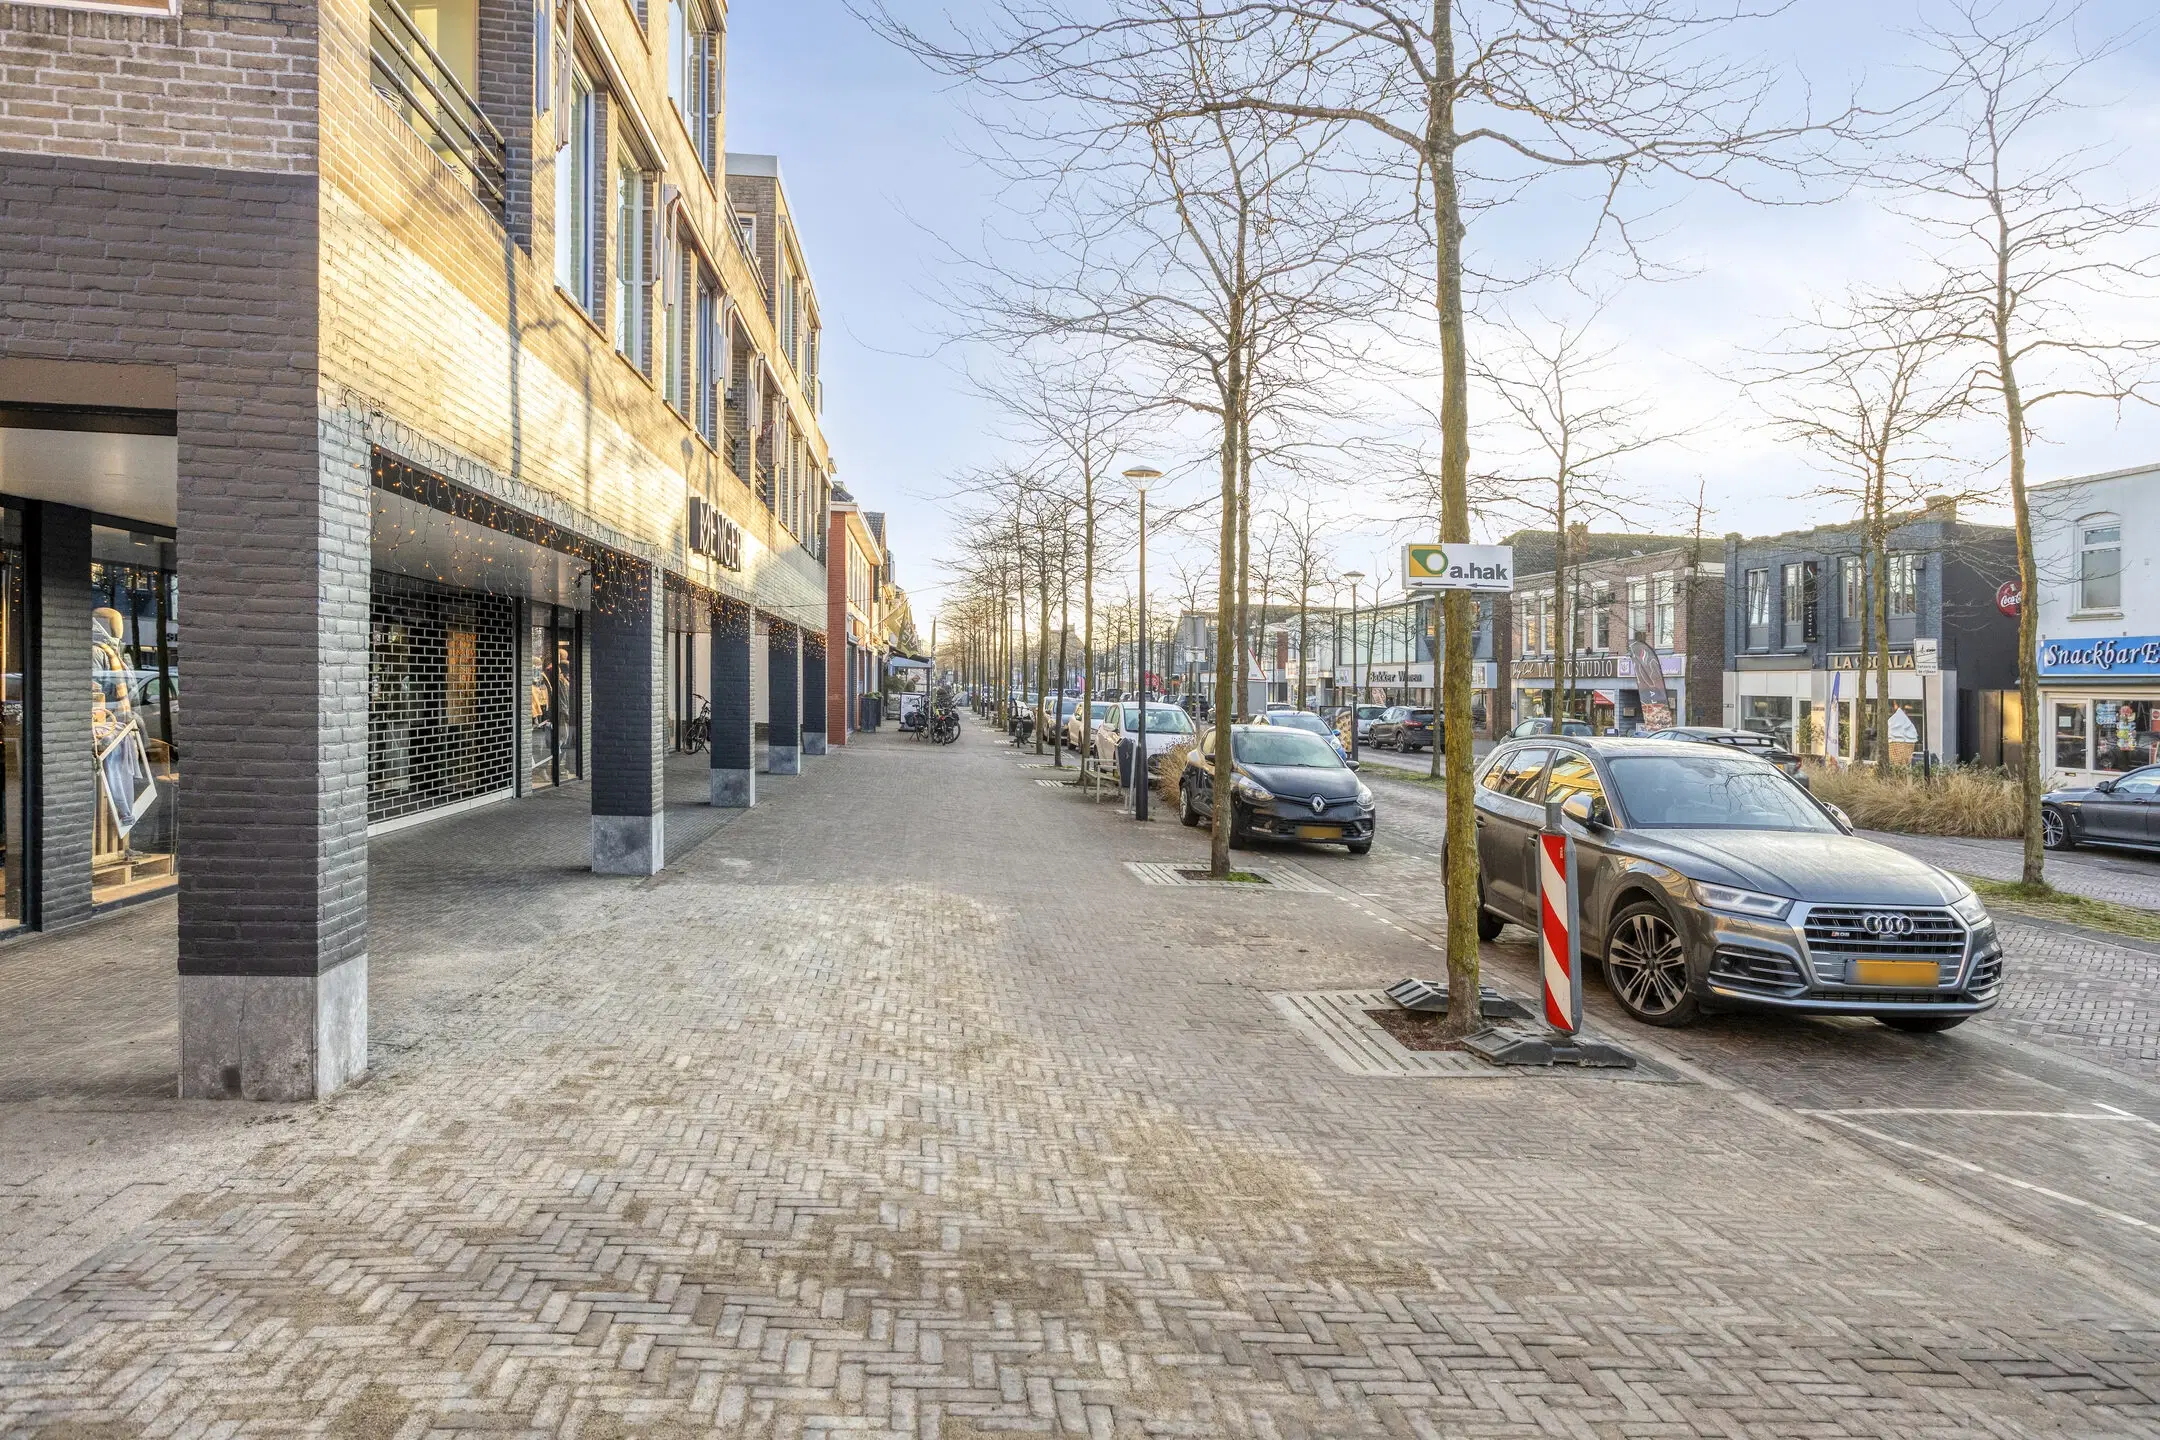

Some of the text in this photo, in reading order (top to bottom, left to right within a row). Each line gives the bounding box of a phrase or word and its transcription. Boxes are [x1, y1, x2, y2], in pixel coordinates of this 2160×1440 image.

[1449, 562, 1508, 581] a.hak
[1833, 655, 1853, 669] LA
[2047, 640, 2141, 670] Snackbar
[1537, 660, 1613, 678] TATOSTUDIO
